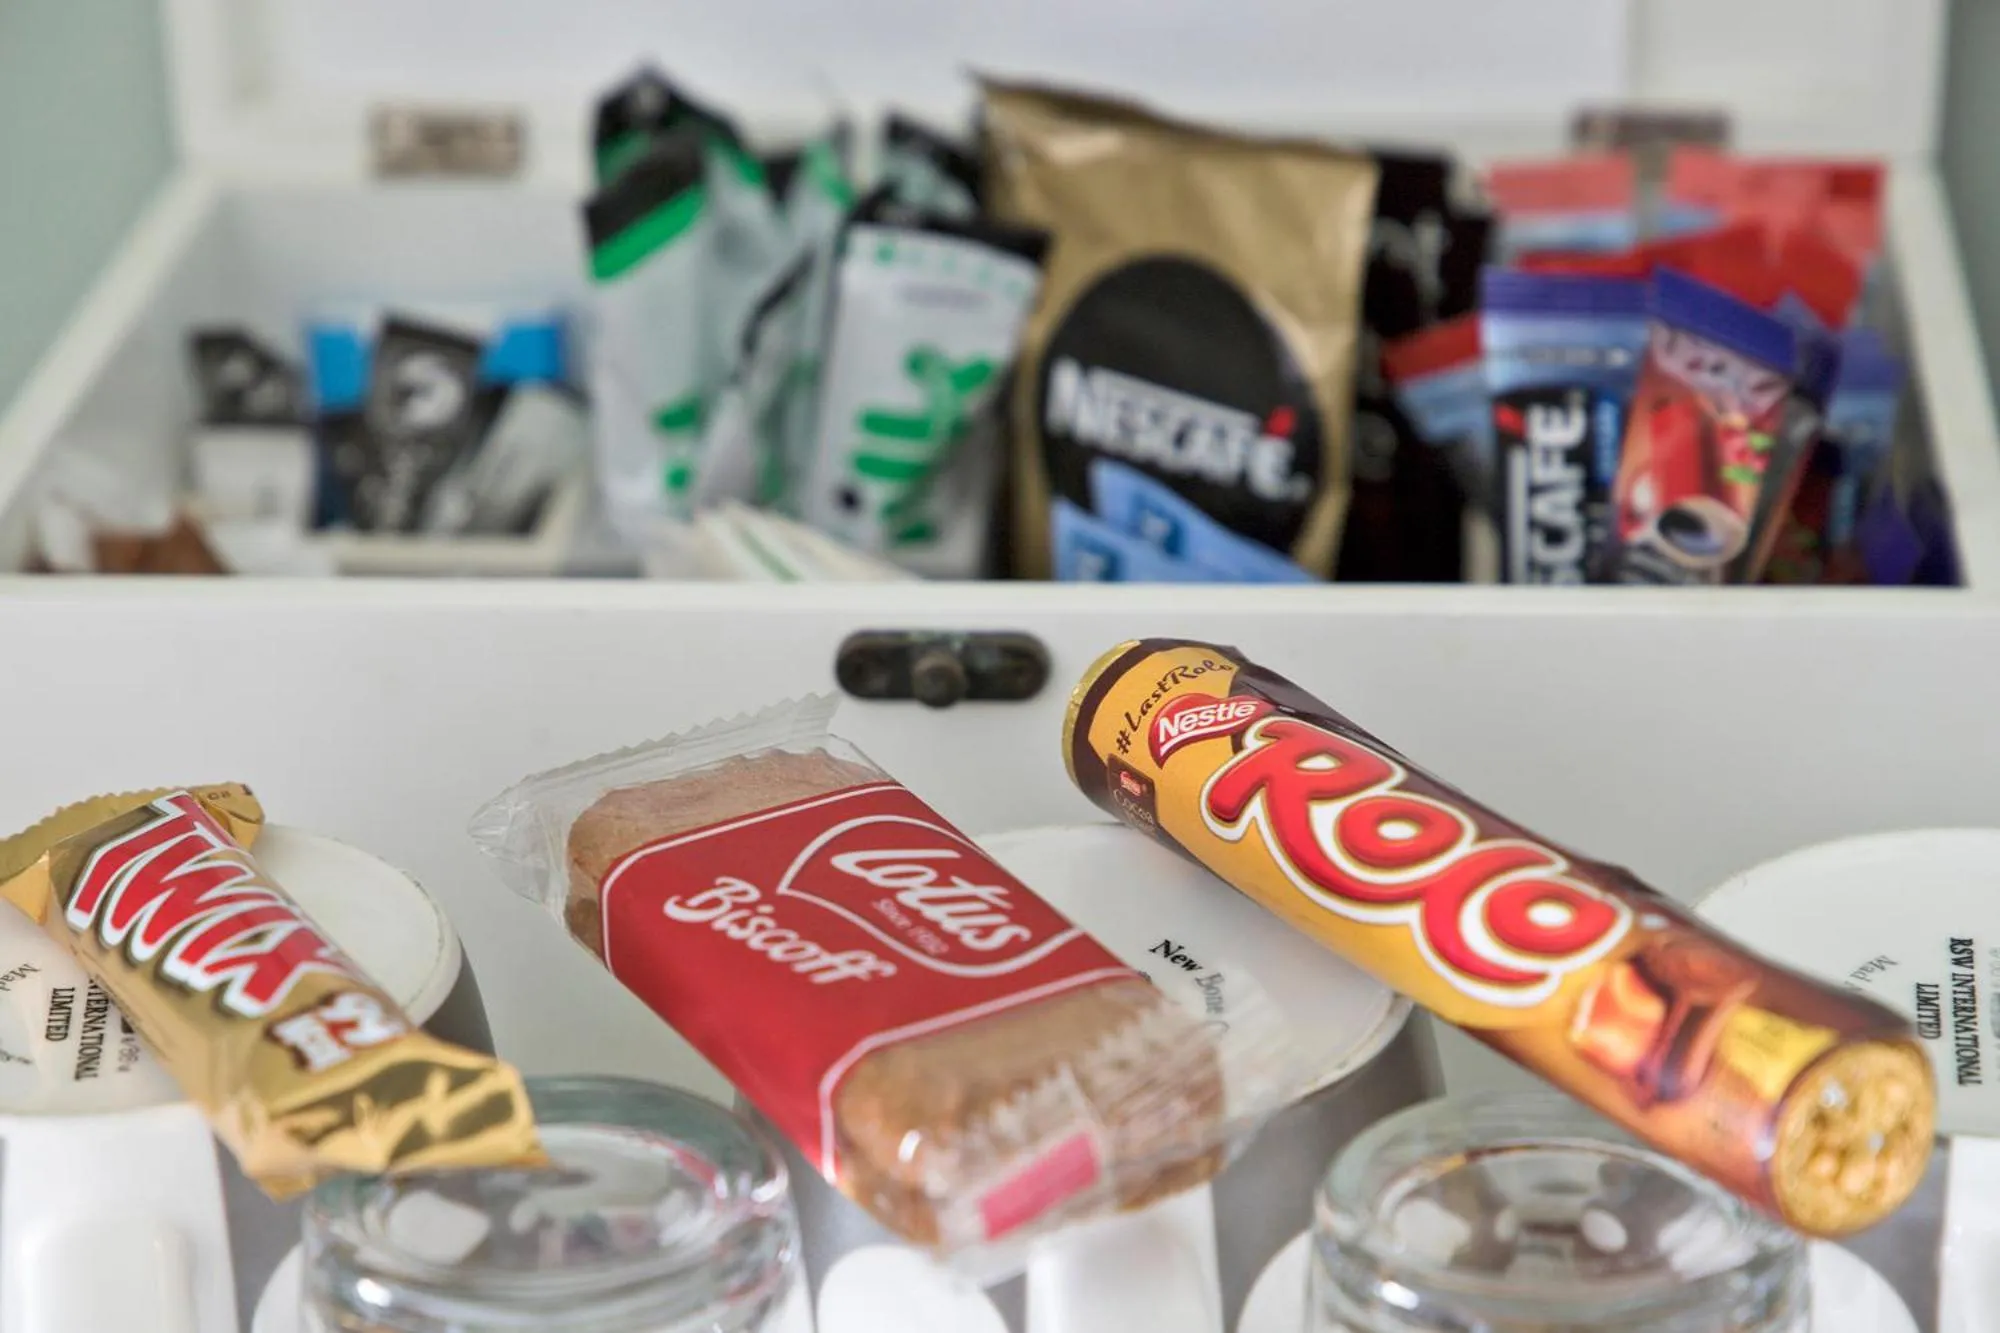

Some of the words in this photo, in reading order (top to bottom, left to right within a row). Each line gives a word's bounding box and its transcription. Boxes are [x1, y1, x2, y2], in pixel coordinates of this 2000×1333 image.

[663, 876, 897, 983] Biscoff
[831, 850, 1031, 951] Lotus
[1149, 939, 1203, 971] New
[45, 987, 76, 1041] LIMITED
[1916, 982, 1941, 1039] LIMITED
[1952, 973, 1982, 1087] INTERNATIONAL
